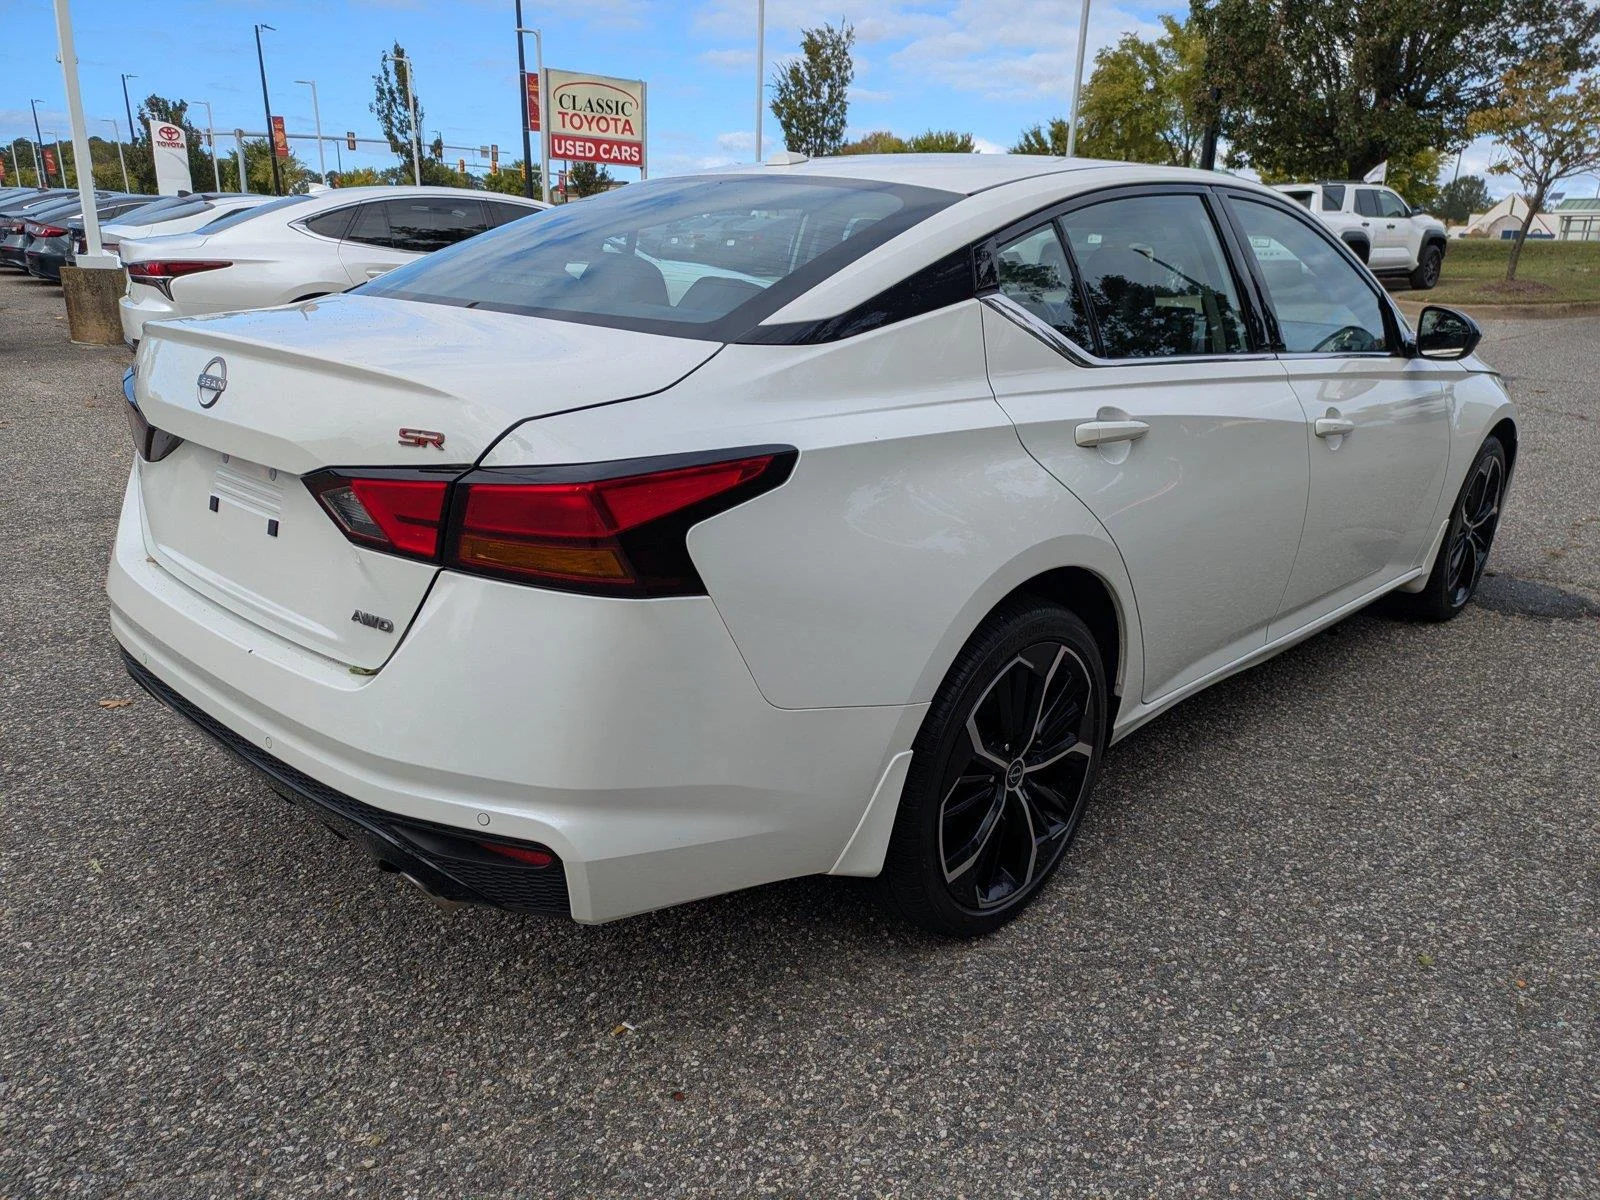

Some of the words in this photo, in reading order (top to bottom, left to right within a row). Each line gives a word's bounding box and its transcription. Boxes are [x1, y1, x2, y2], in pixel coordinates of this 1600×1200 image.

[558, 93, 633, 117] CLASSIC
[557, 111, 635, 136] TOYOTA
[156, 140, 186, 149] TOYOTA
[554, 139, 596, 158] USED
[599, 143, 640, 162] CARS
[198, 375, 226, 391] SSAN
[398, 428, 445, 451] SR
[351, 609, 394, 633] AWD
